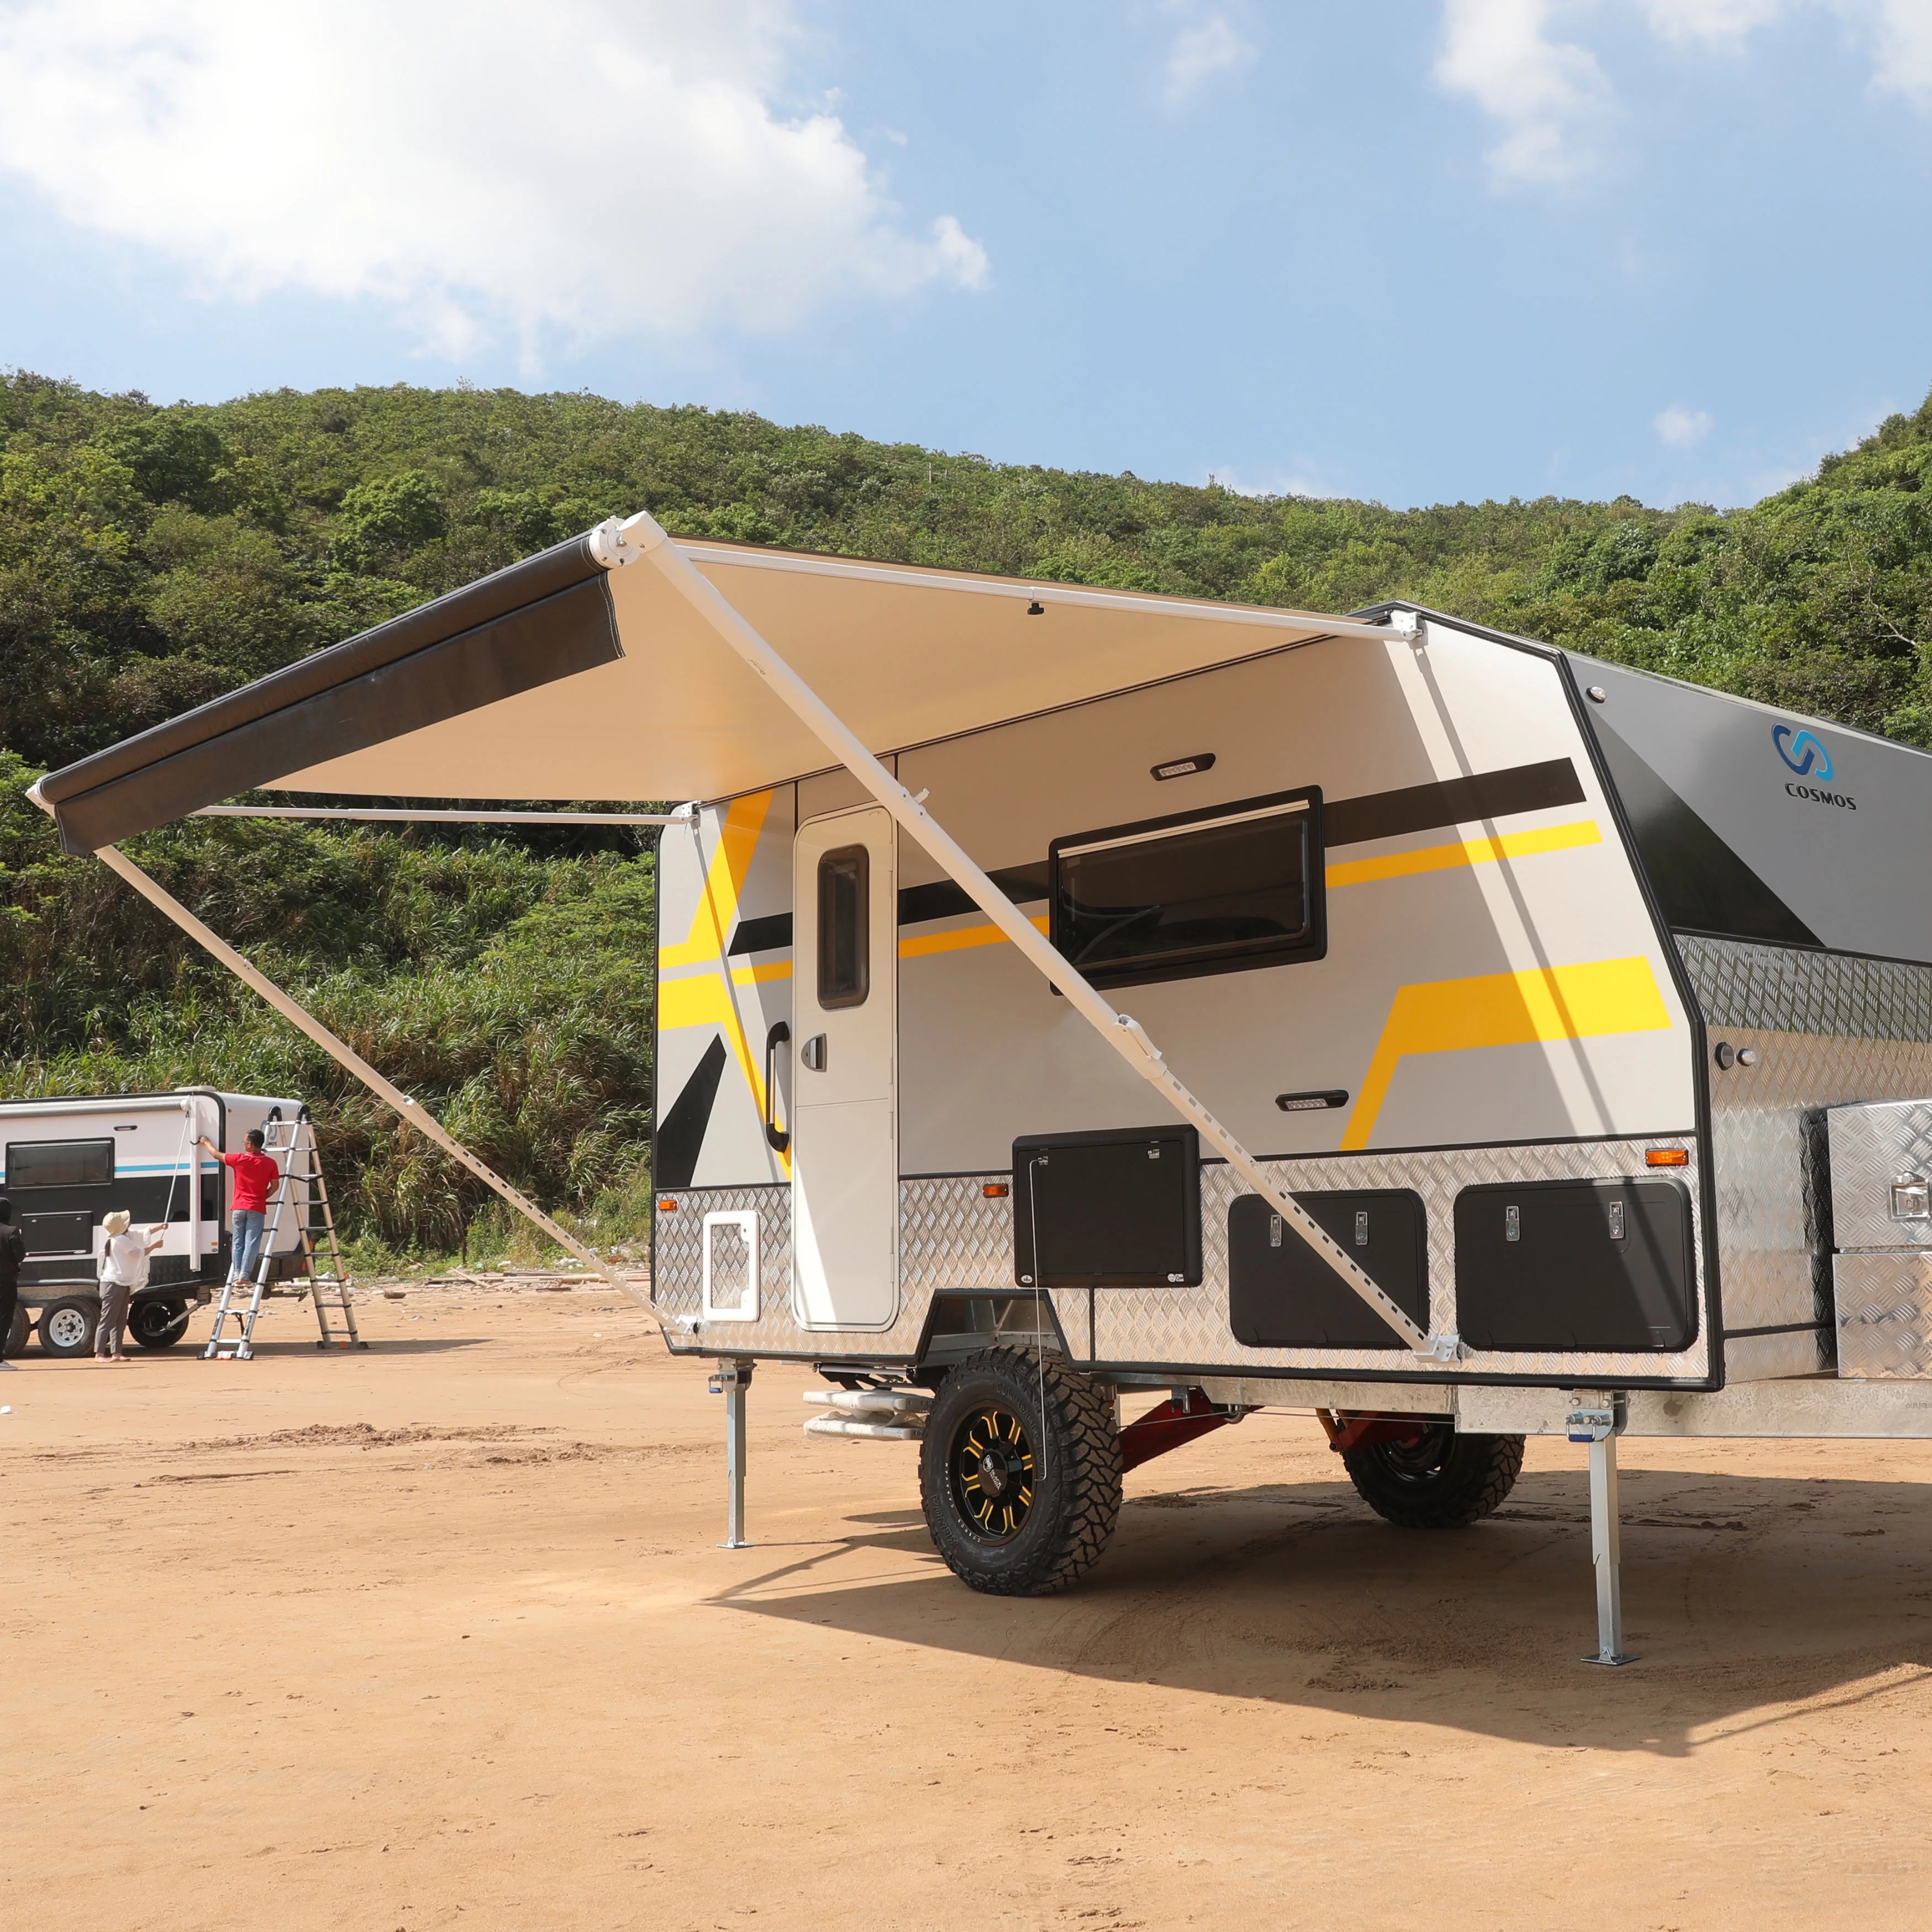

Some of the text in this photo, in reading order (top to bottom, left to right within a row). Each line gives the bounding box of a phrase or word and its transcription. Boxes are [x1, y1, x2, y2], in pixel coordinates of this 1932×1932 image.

[1785, 782, 1856, 810] COSMOS
[997, 1382, 1040, 1439] KLEVER
[944, 1462, 954, 1508] CARAVAN
[931, 1494, 959, 1546] KENDA
